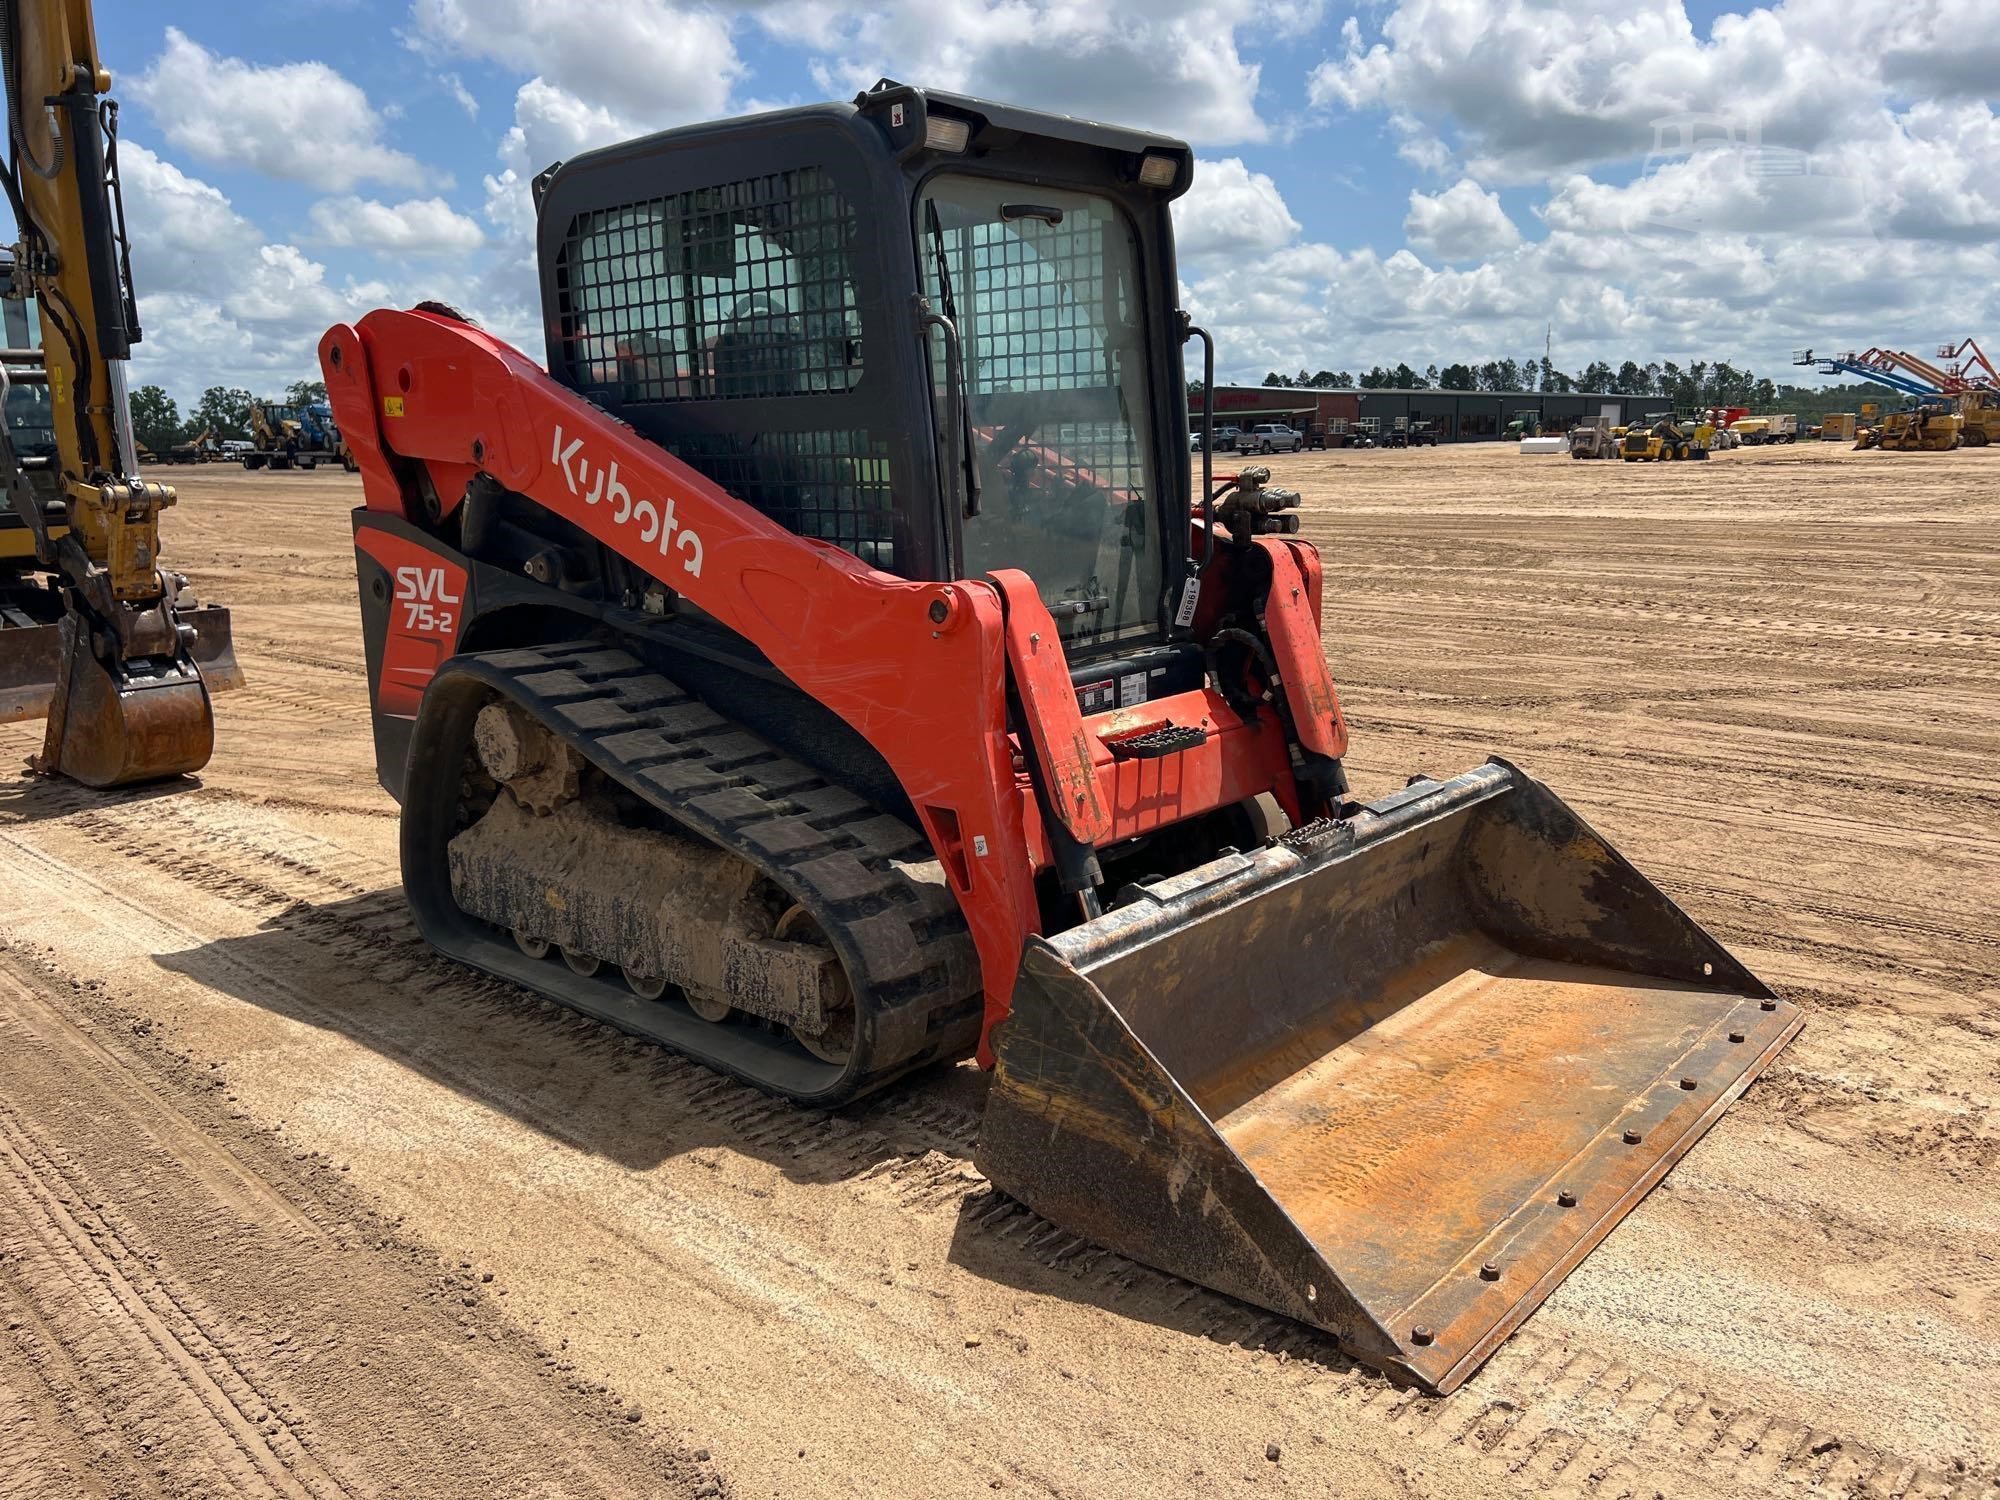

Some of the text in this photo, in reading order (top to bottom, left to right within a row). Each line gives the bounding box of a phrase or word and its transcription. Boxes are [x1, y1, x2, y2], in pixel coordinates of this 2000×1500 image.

[552, 424, 703, 578] Kubota
[396, 566, 459, 604] SVL
[403, 602, 452, 633] 75-2
[1182, 589, 1197, 621] 196368
